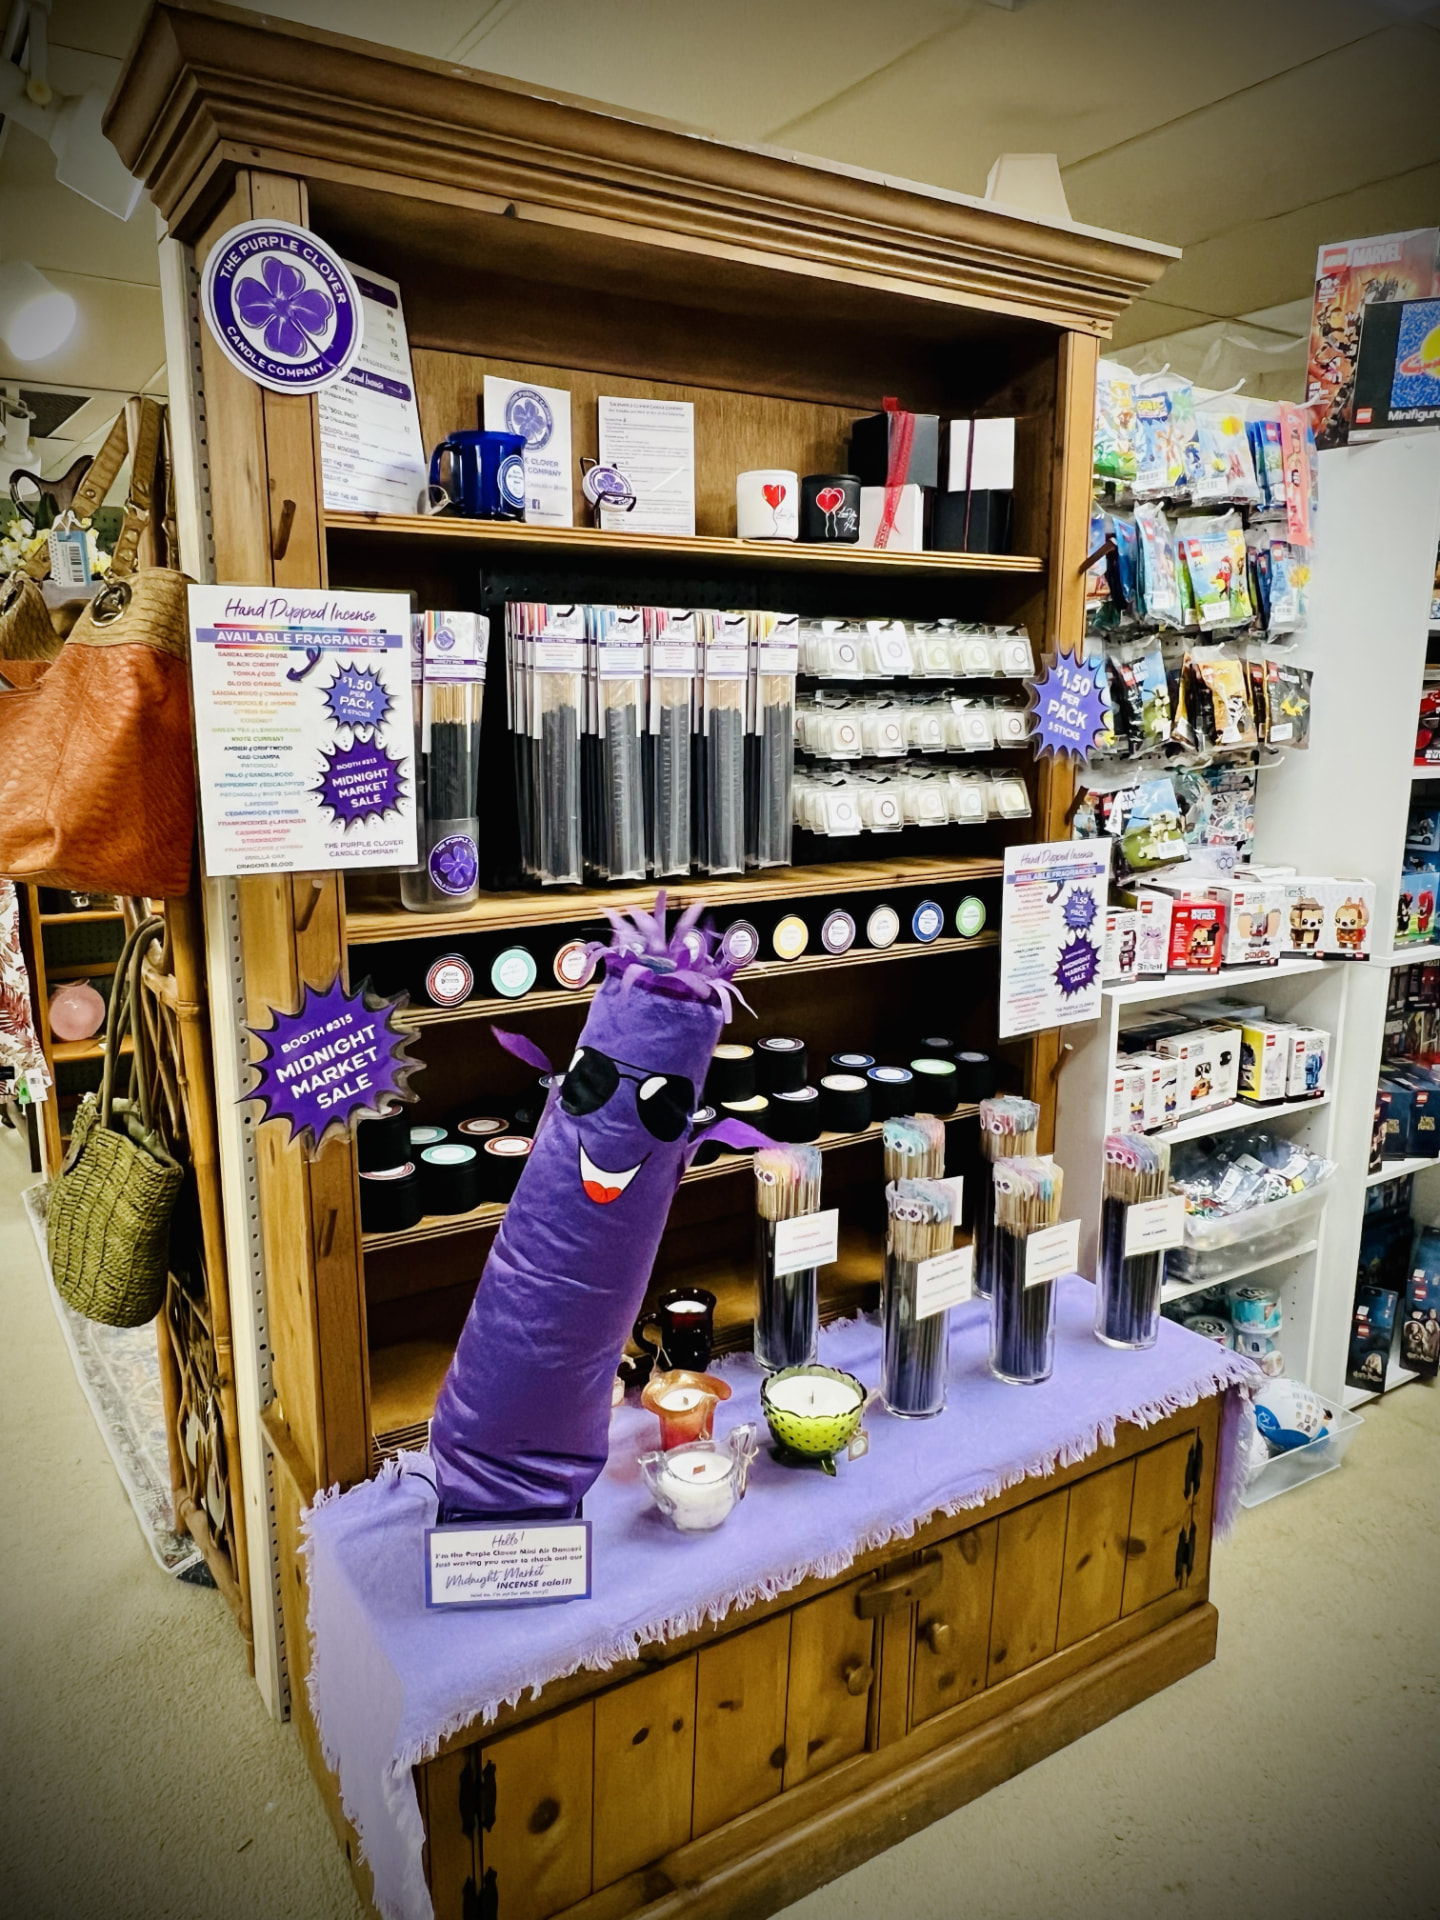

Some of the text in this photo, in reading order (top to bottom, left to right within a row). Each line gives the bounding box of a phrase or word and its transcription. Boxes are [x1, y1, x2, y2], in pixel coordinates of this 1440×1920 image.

[219, 236, 347, 304] THE PURPLE CLOVER
[226, 325, 325, 379] CANDLE COMPANY
[530, 458, 559, 468] CLOVER
[527, 467, 562, 478] COMPANY
[224, 597, 377, 623] Hand Dipped Incense
[216, 631, 386, 648] AVAILABLE FRAGRANCES
[342, 676, 373, 692] $1.50
[1056, 665, 1091, 697] $1.50
[339, 695, 375, 711] PACK
[349, 690, 366, 699] PER
[1061, 691, 1081, 708] PER
[1046, 698, 1089, 731] PACK
[1053, 724, 1081, 741] STICKS
[336, 761, 361, 771] BOOTH
[331, 768, 389, 788] MIDNIGHT
[338, 780, 389, 799] MARKET
[350, 794, 382, 809] SALE
[329, 848, 399, 857] CANDLE COMPANY
[340, 841, 372, 849] PURPLE
[373, 839, 404, 848] CLOVER
[1020, 851, 1042, 865] Hand
[1064, 962, 1090, 978] MARKET
[1069, 972, 1087, 984] SALE
[280, 1013, 354, 1054] BOOTH #315
[275, 1023, 376, 1084] MIDNIGHT
[290, 1045, 378, 1100] MARKET
[316, 1072, 374, 1110] SALE
[491, 1530, 526, 1549] Hello!
[435, 1552, 450, 1560] I'm
[450, 1551, 464, 1559] the
[465, 1550, 491, 1560] Purple
[492, 1549, 518, 1557] Clover
[519, 1547, 537, 1556] Mini
[538, 1547, 550, 1555] Air
[435, 1560, 451, 1569] Just
[452, 1559, 482, 1568] waving
[484, 1559, 499, 1567] you
[530, 1555, 553, 1564] check
[554, 1555, 569, 1563] out
[445, 1564, 546, 1591] Midnight Market
[496, 1579, 540, 1590] INCENSE
